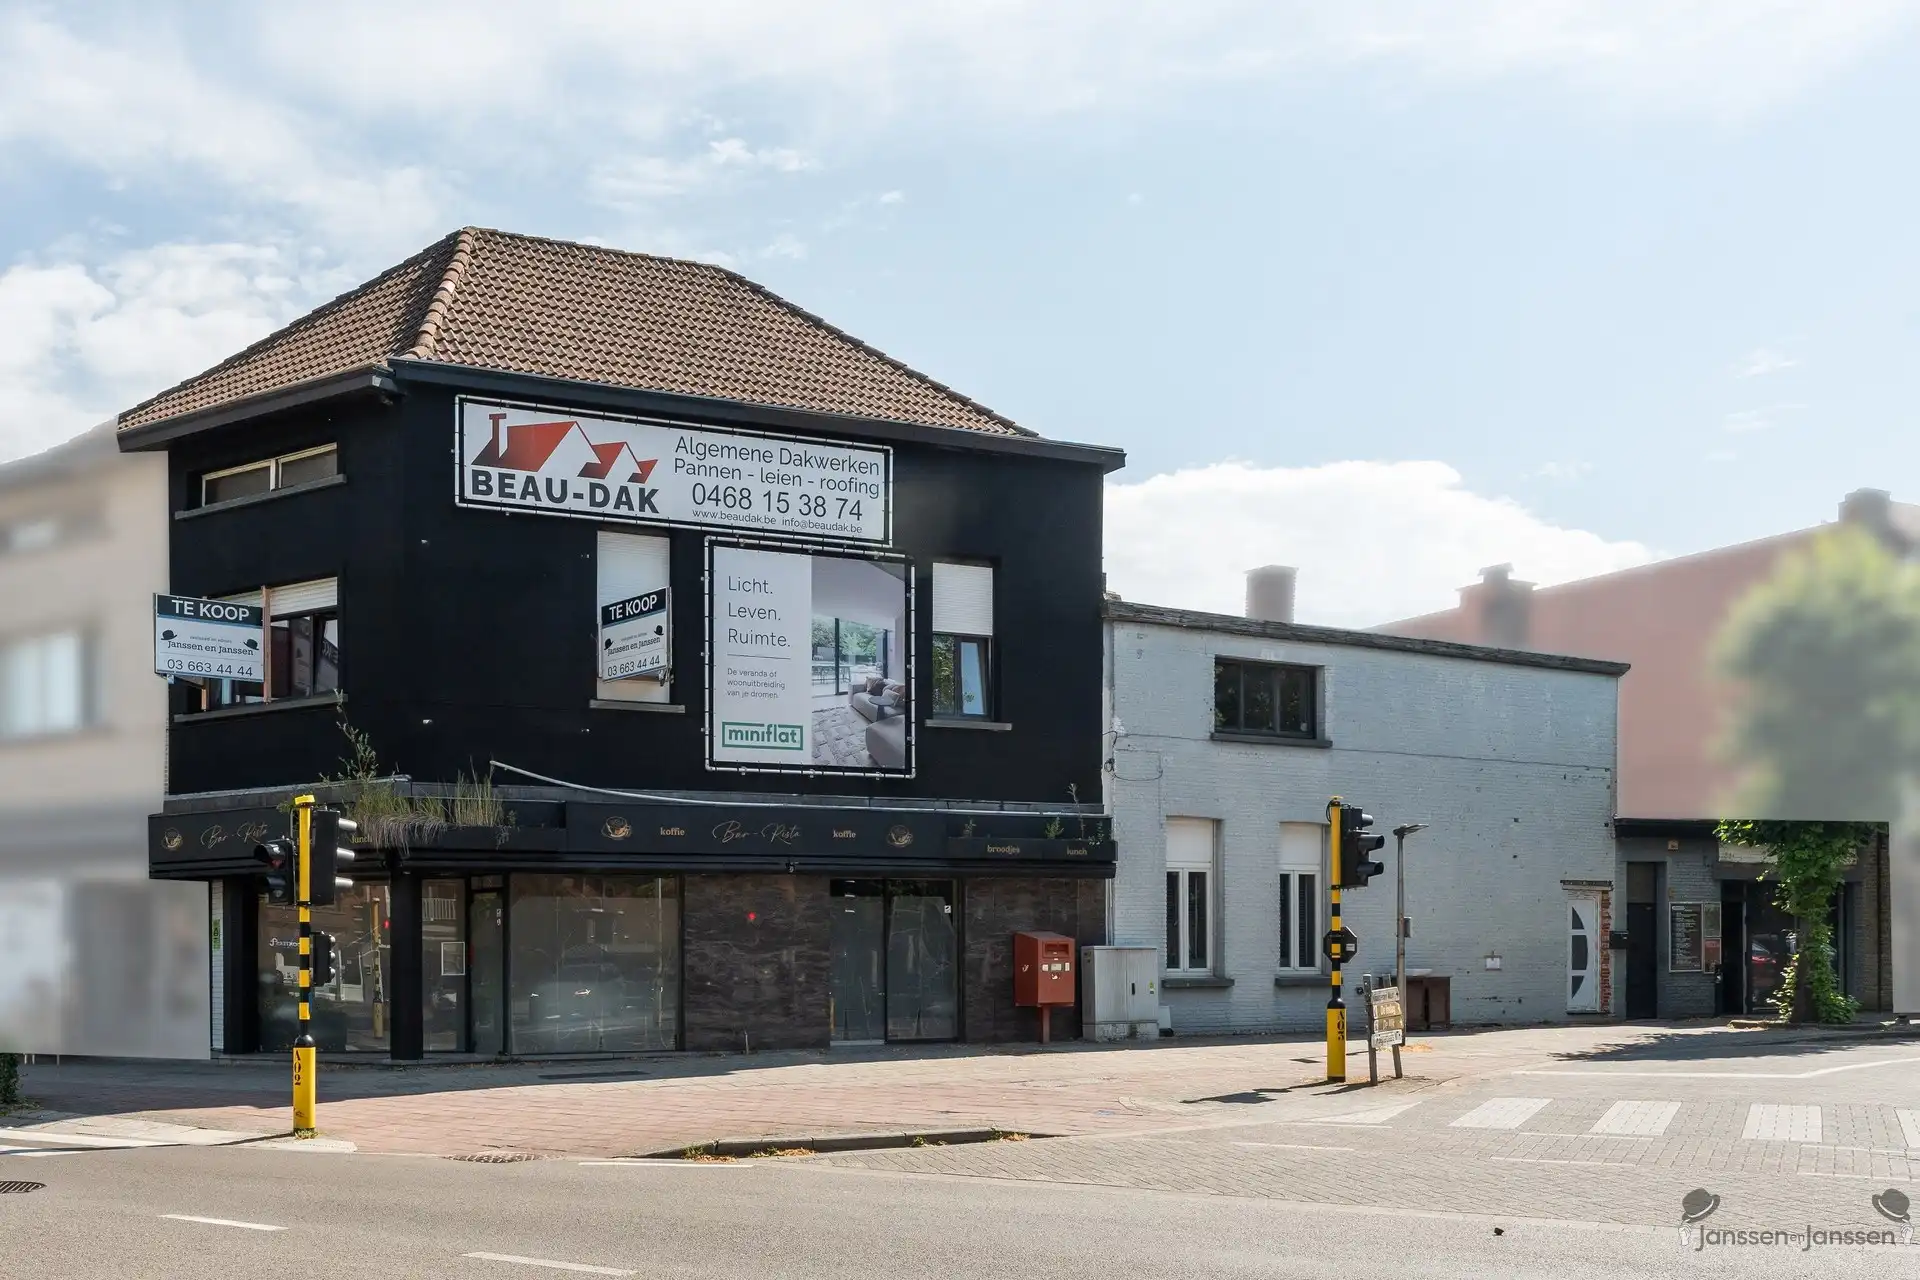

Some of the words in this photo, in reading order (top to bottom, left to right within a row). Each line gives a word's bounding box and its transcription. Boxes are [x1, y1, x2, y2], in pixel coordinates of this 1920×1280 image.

[675, 436, 774, 463] Algemene
[779, 447, 880, 475] Dakwerken
[674, 458, 742, 480] Pannen
[760, 467, 802, 487] leien
[820, 476, 880, 499] roofing
[471, 469, 660, 514] BEAU-DAK
[692, 482, 752, 510] 0468
[763, 490, 790, 514] 15
[799, 493, 827, 518] 38
[835, 497, 863, 521] 74
[692, 509, 777, 525] www.beaudak.be
[782, 518, 863, 534] info@beaudak.be
[728, 575, 773, 594] Licht.
[171, 599, 195, 616] TE
[199, 603, 250, 621] KOOP
[609, 604, 623, 620] TE
[625, 594, 658, 616] KOOP
[728, 602, 781, 621] Leven.
[607, 644, 630, 656] Janssen
[630, 642, 638, 650] en
[638, 637, 661, 649] Janssen
[728, 628, 791, 647] Ruimte.
[168, 640, 203, 652] Janssen
[204, 645, 217, 653] en
[218, 645, 254, 656] Janssen
[167, 659, 183, 670] 03
[187, 661, 212, 673] 663
[216, 664, 233, 675] 44
[237, 666, 253, 677] 44
[608, 665, 618, 677] 03
[619, 661, 635, 674] 663
[637, 658, 647, 669] 44
[649, 655, 660, 665] 44
[727, 668, 737, 676] De
[727, 680, 786, 690] woonuitbreiding
[728, 724, 797, 743] miniflat
[660, 827, 686, 837] koffie
[832, 829, 857, 839] koffie
[987, 845, 1020, 855] broodjes
[1066, 846, 1088, 855] lunch
